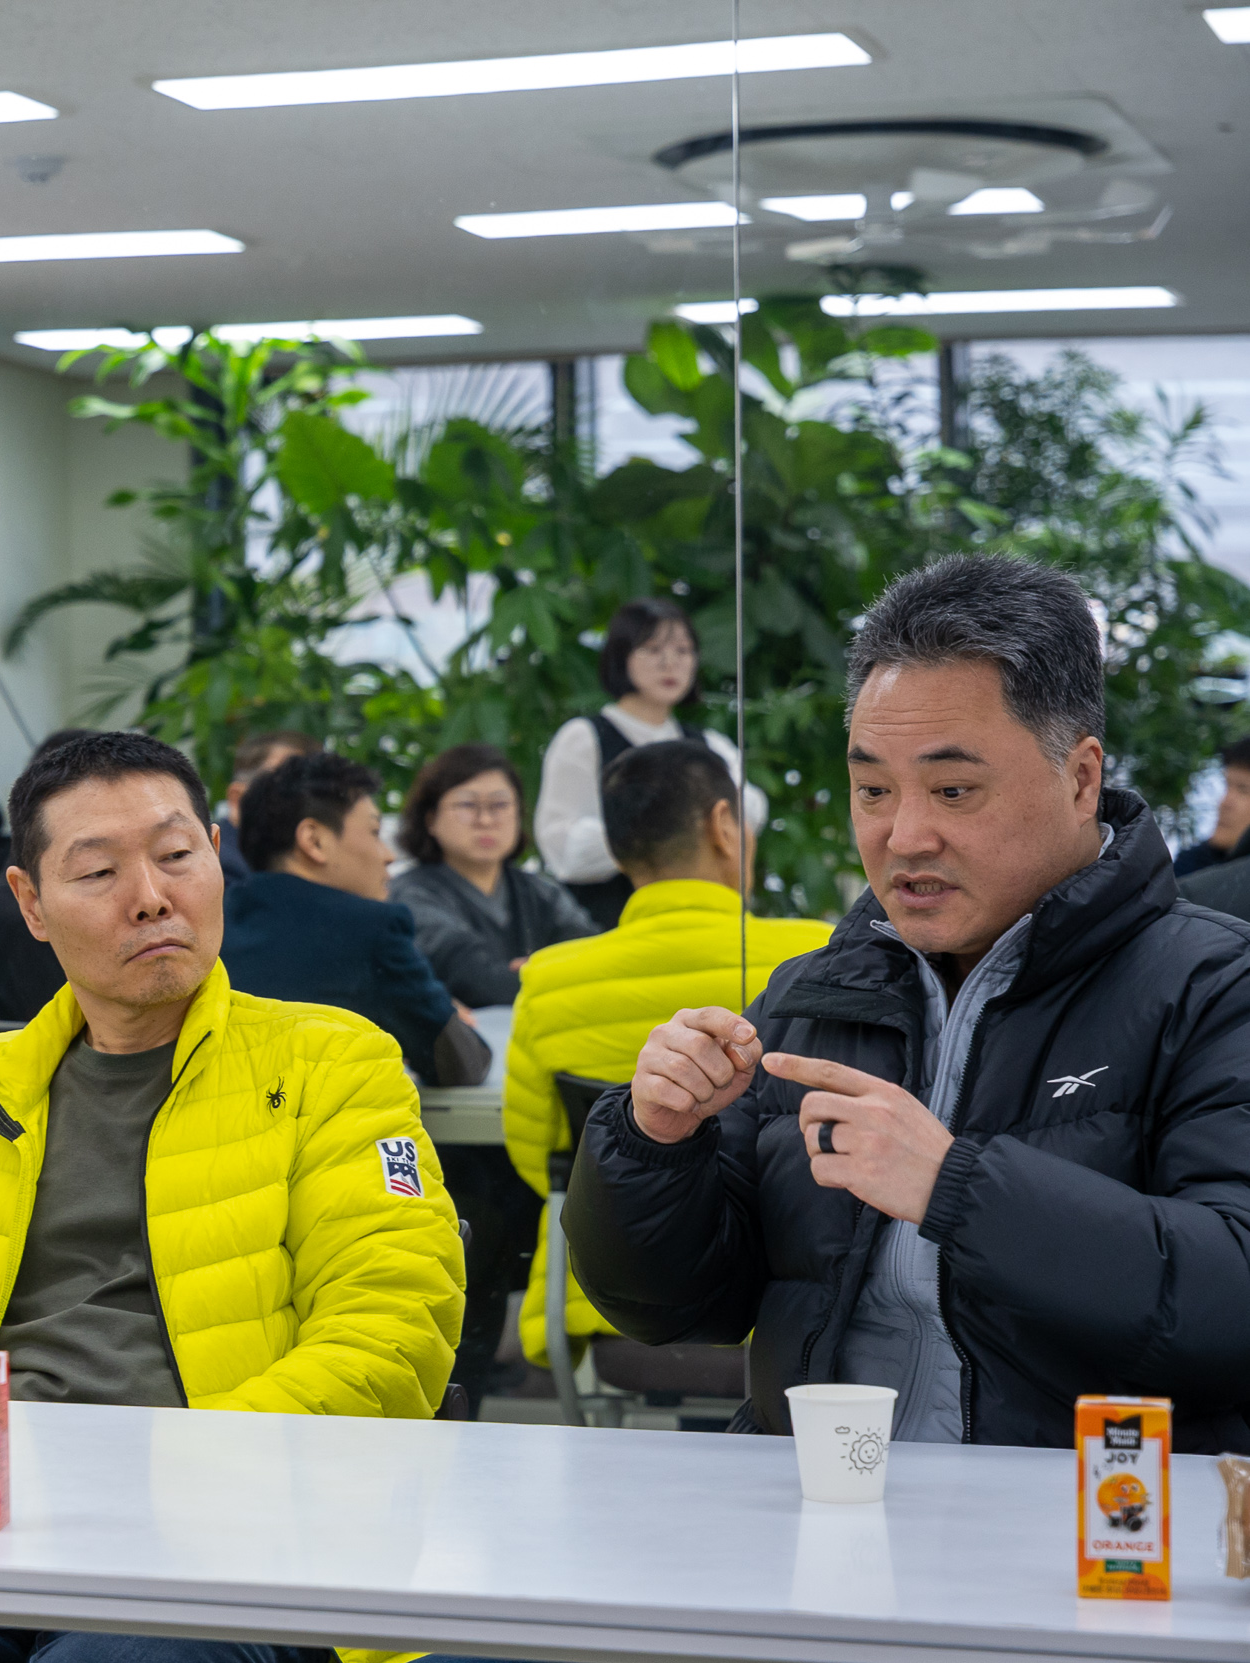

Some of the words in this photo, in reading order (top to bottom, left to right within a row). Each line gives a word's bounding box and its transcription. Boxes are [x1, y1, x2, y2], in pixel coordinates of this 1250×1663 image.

[381, 1141, 415, 1162] US
[1105, 1452, 1139, 1464] JOY
[1092, 1540, 1154, 1551] ORANGE
